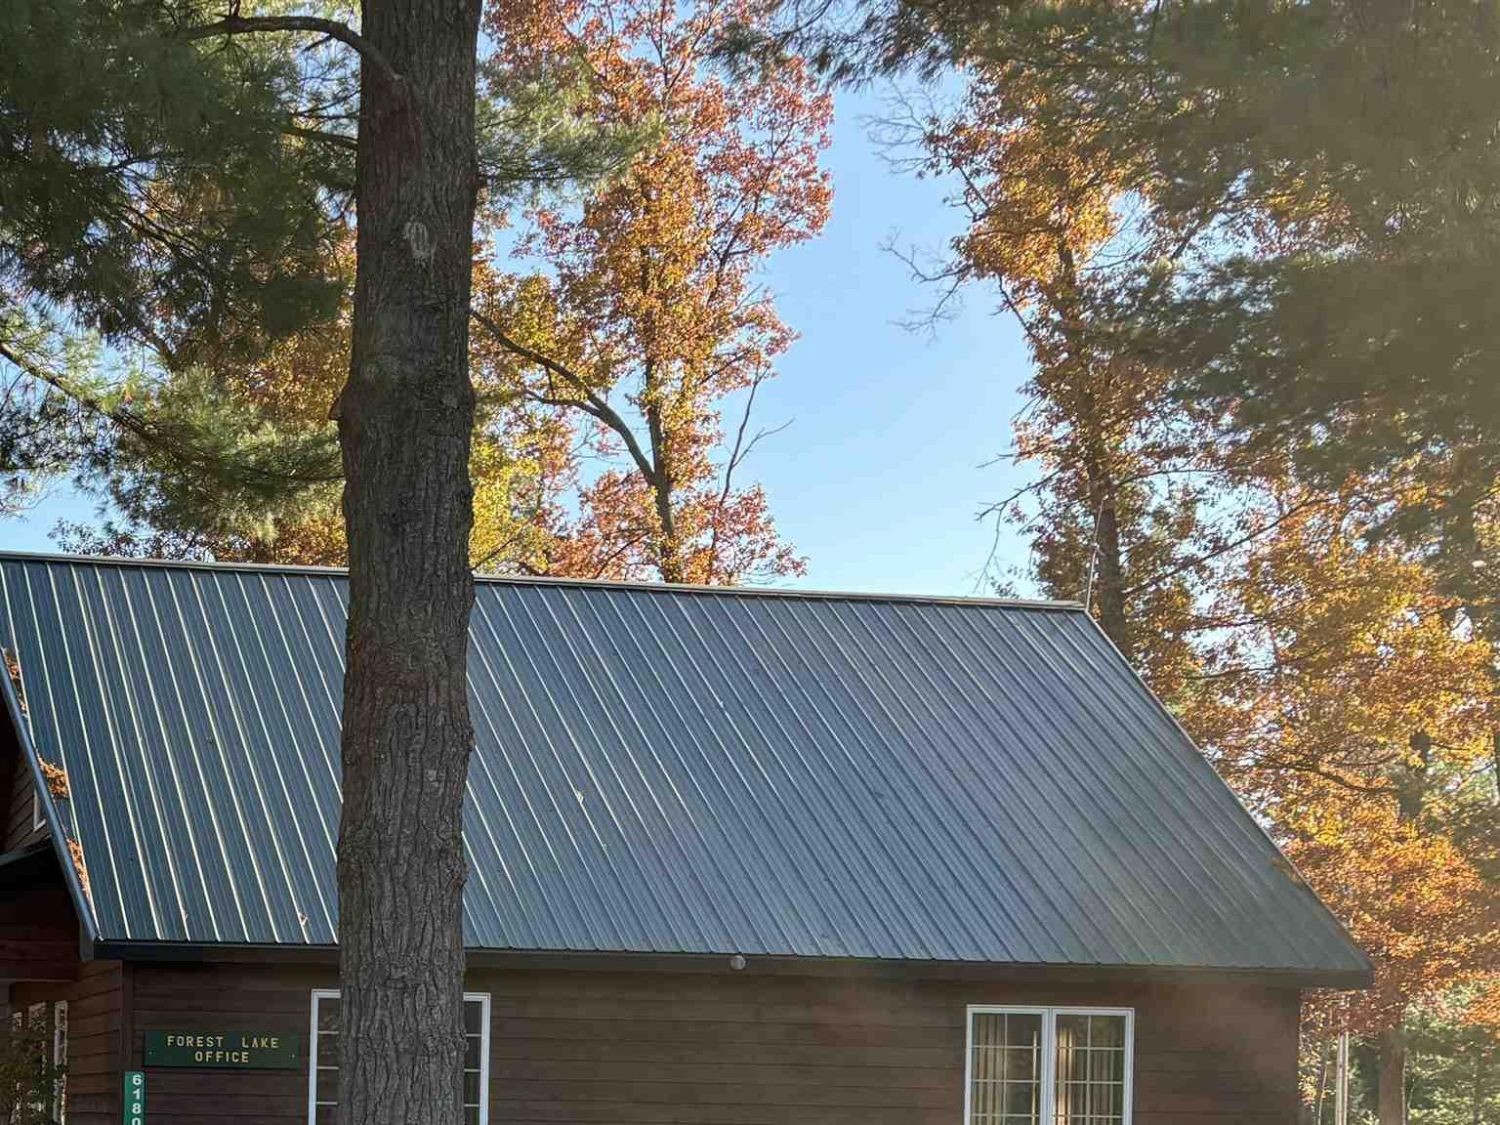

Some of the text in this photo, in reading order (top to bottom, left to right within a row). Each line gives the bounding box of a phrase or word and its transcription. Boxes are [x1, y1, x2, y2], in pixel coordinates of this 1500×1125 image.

[166, 1035, 280, 1049] FOREST LAKE
[194, 1051, 250, 1063] OFFICE
